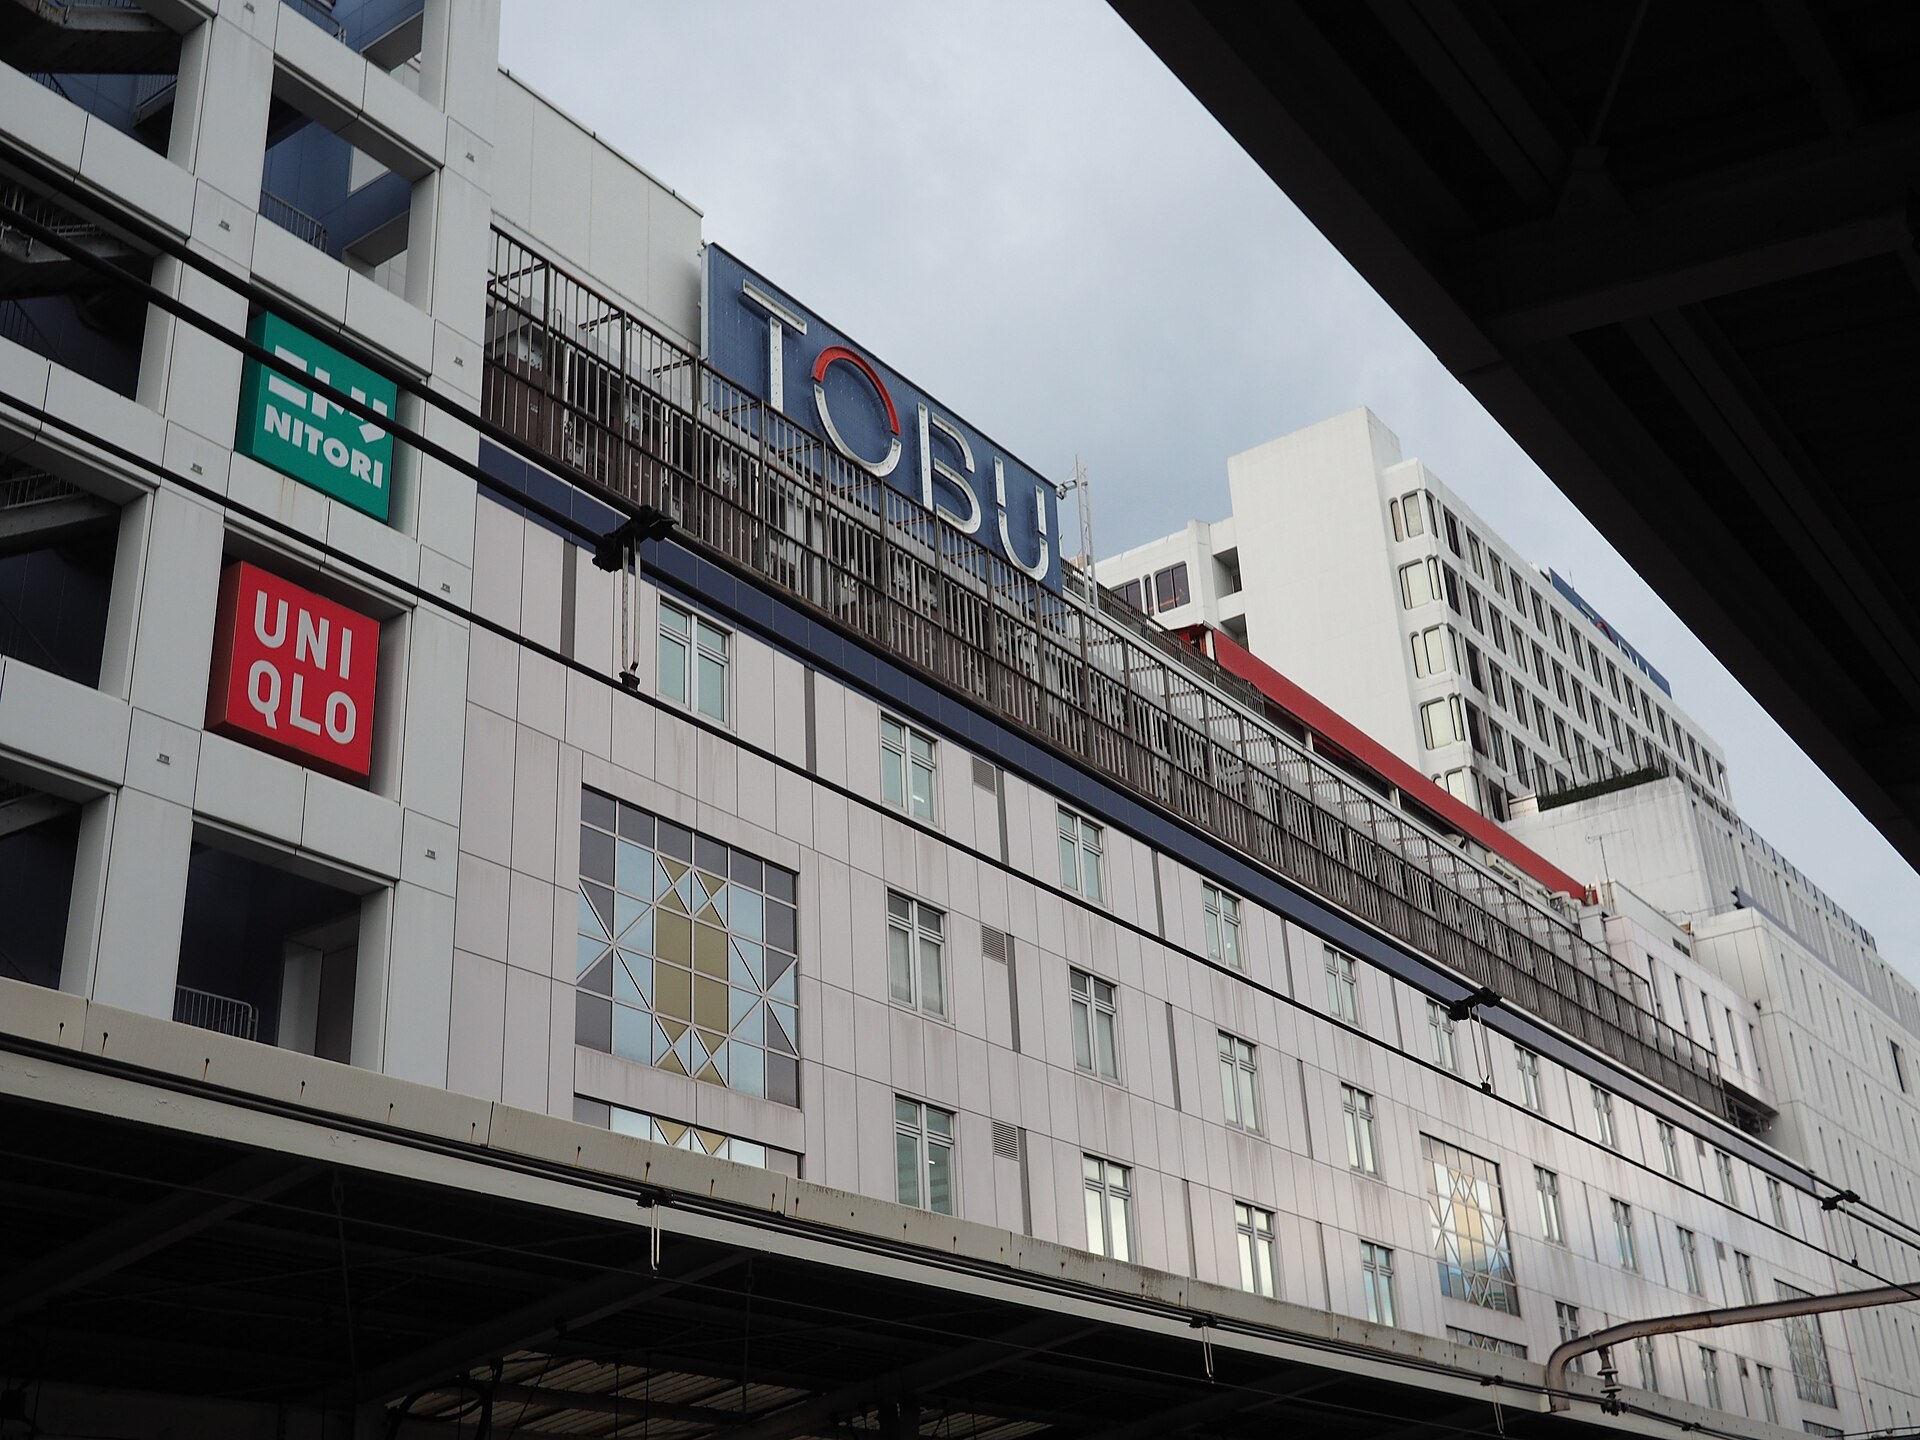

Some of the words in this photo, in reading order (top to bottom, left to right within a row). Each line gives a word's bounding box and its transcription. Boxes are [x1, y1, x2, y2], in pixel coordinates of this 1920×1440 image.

[267, 344, 388, 444] ニトリ
[742, 279, 1049, 582] TOBU
[264, 403, 384, 489] NITORI
[254, 589, 352, 681] UNI
[247, 659, 357, 744] QLO
